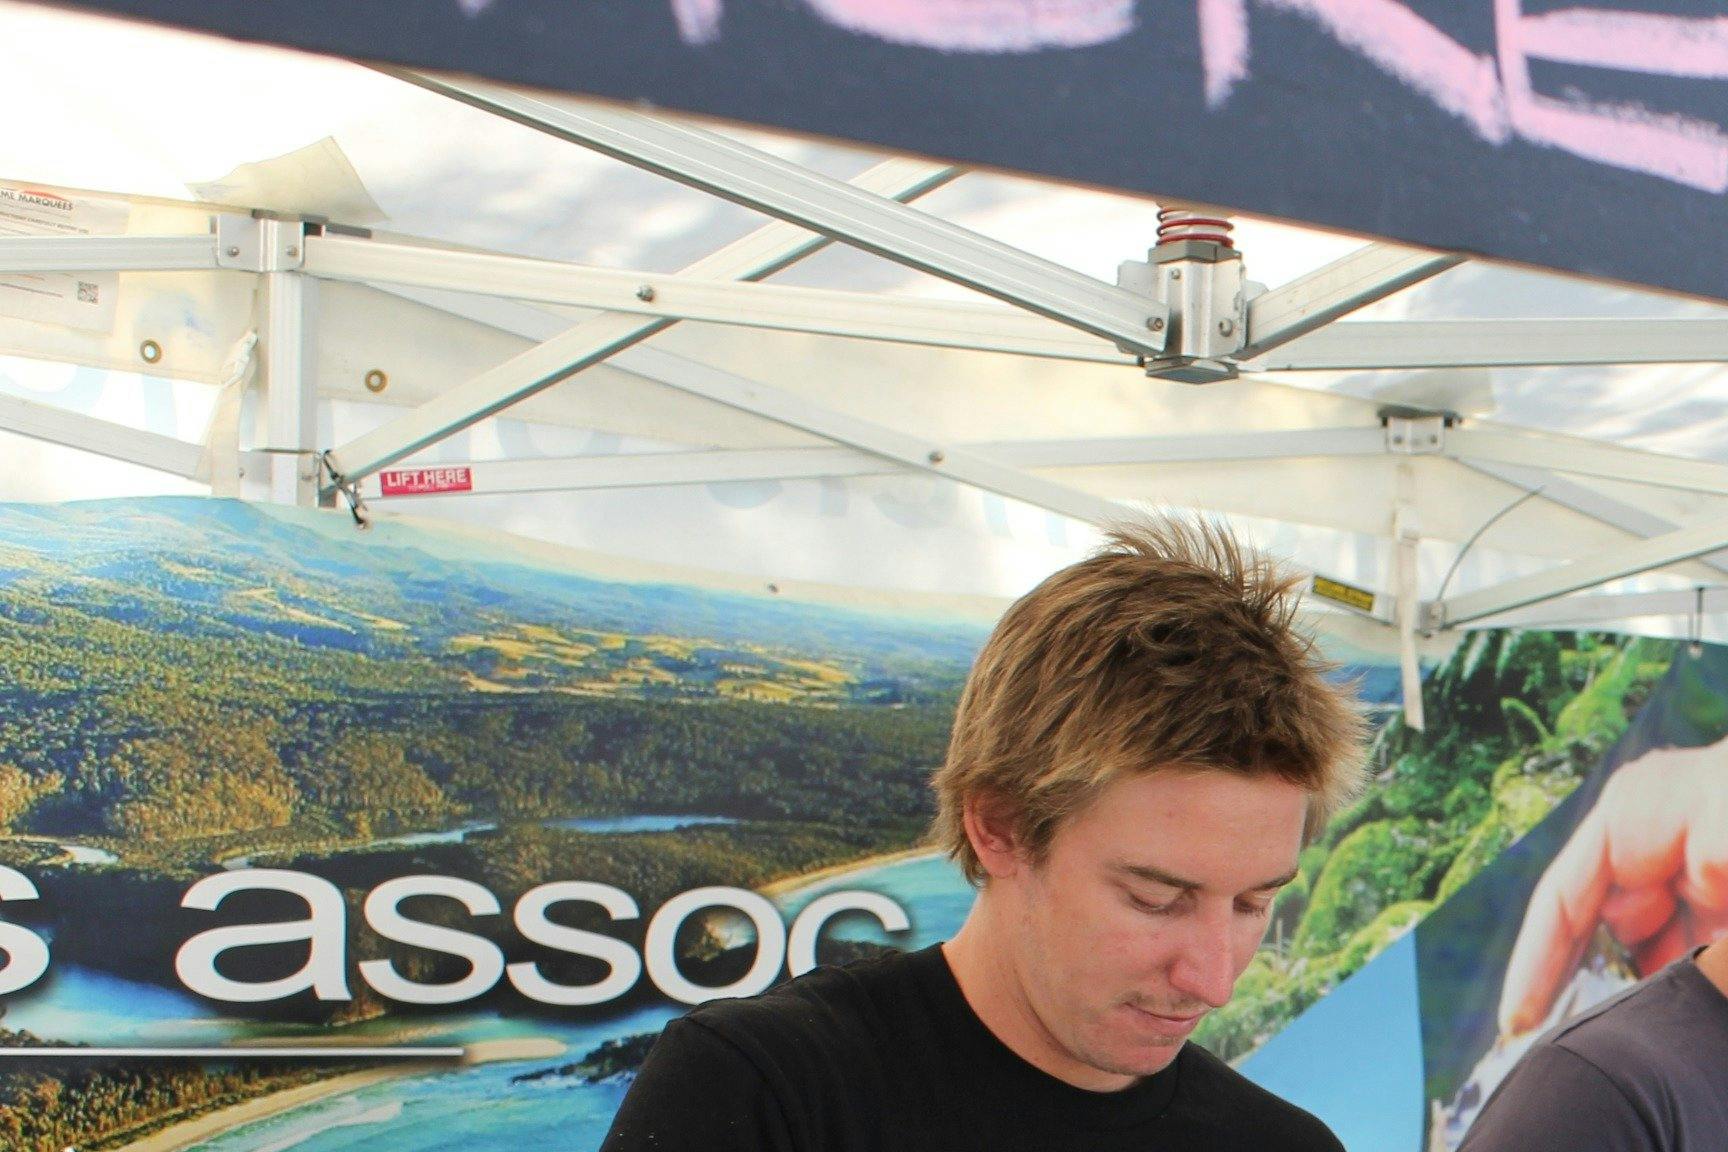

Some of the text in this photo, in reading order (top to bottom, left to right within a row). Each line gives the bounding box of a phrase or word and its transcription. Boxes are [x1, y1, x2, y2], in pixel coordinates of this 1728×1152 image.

[18, 194, 74, 211] MARQUEES
[387, 469, 467, 487] LIFT HERE
[173, 867, 913, 1007] assoc
